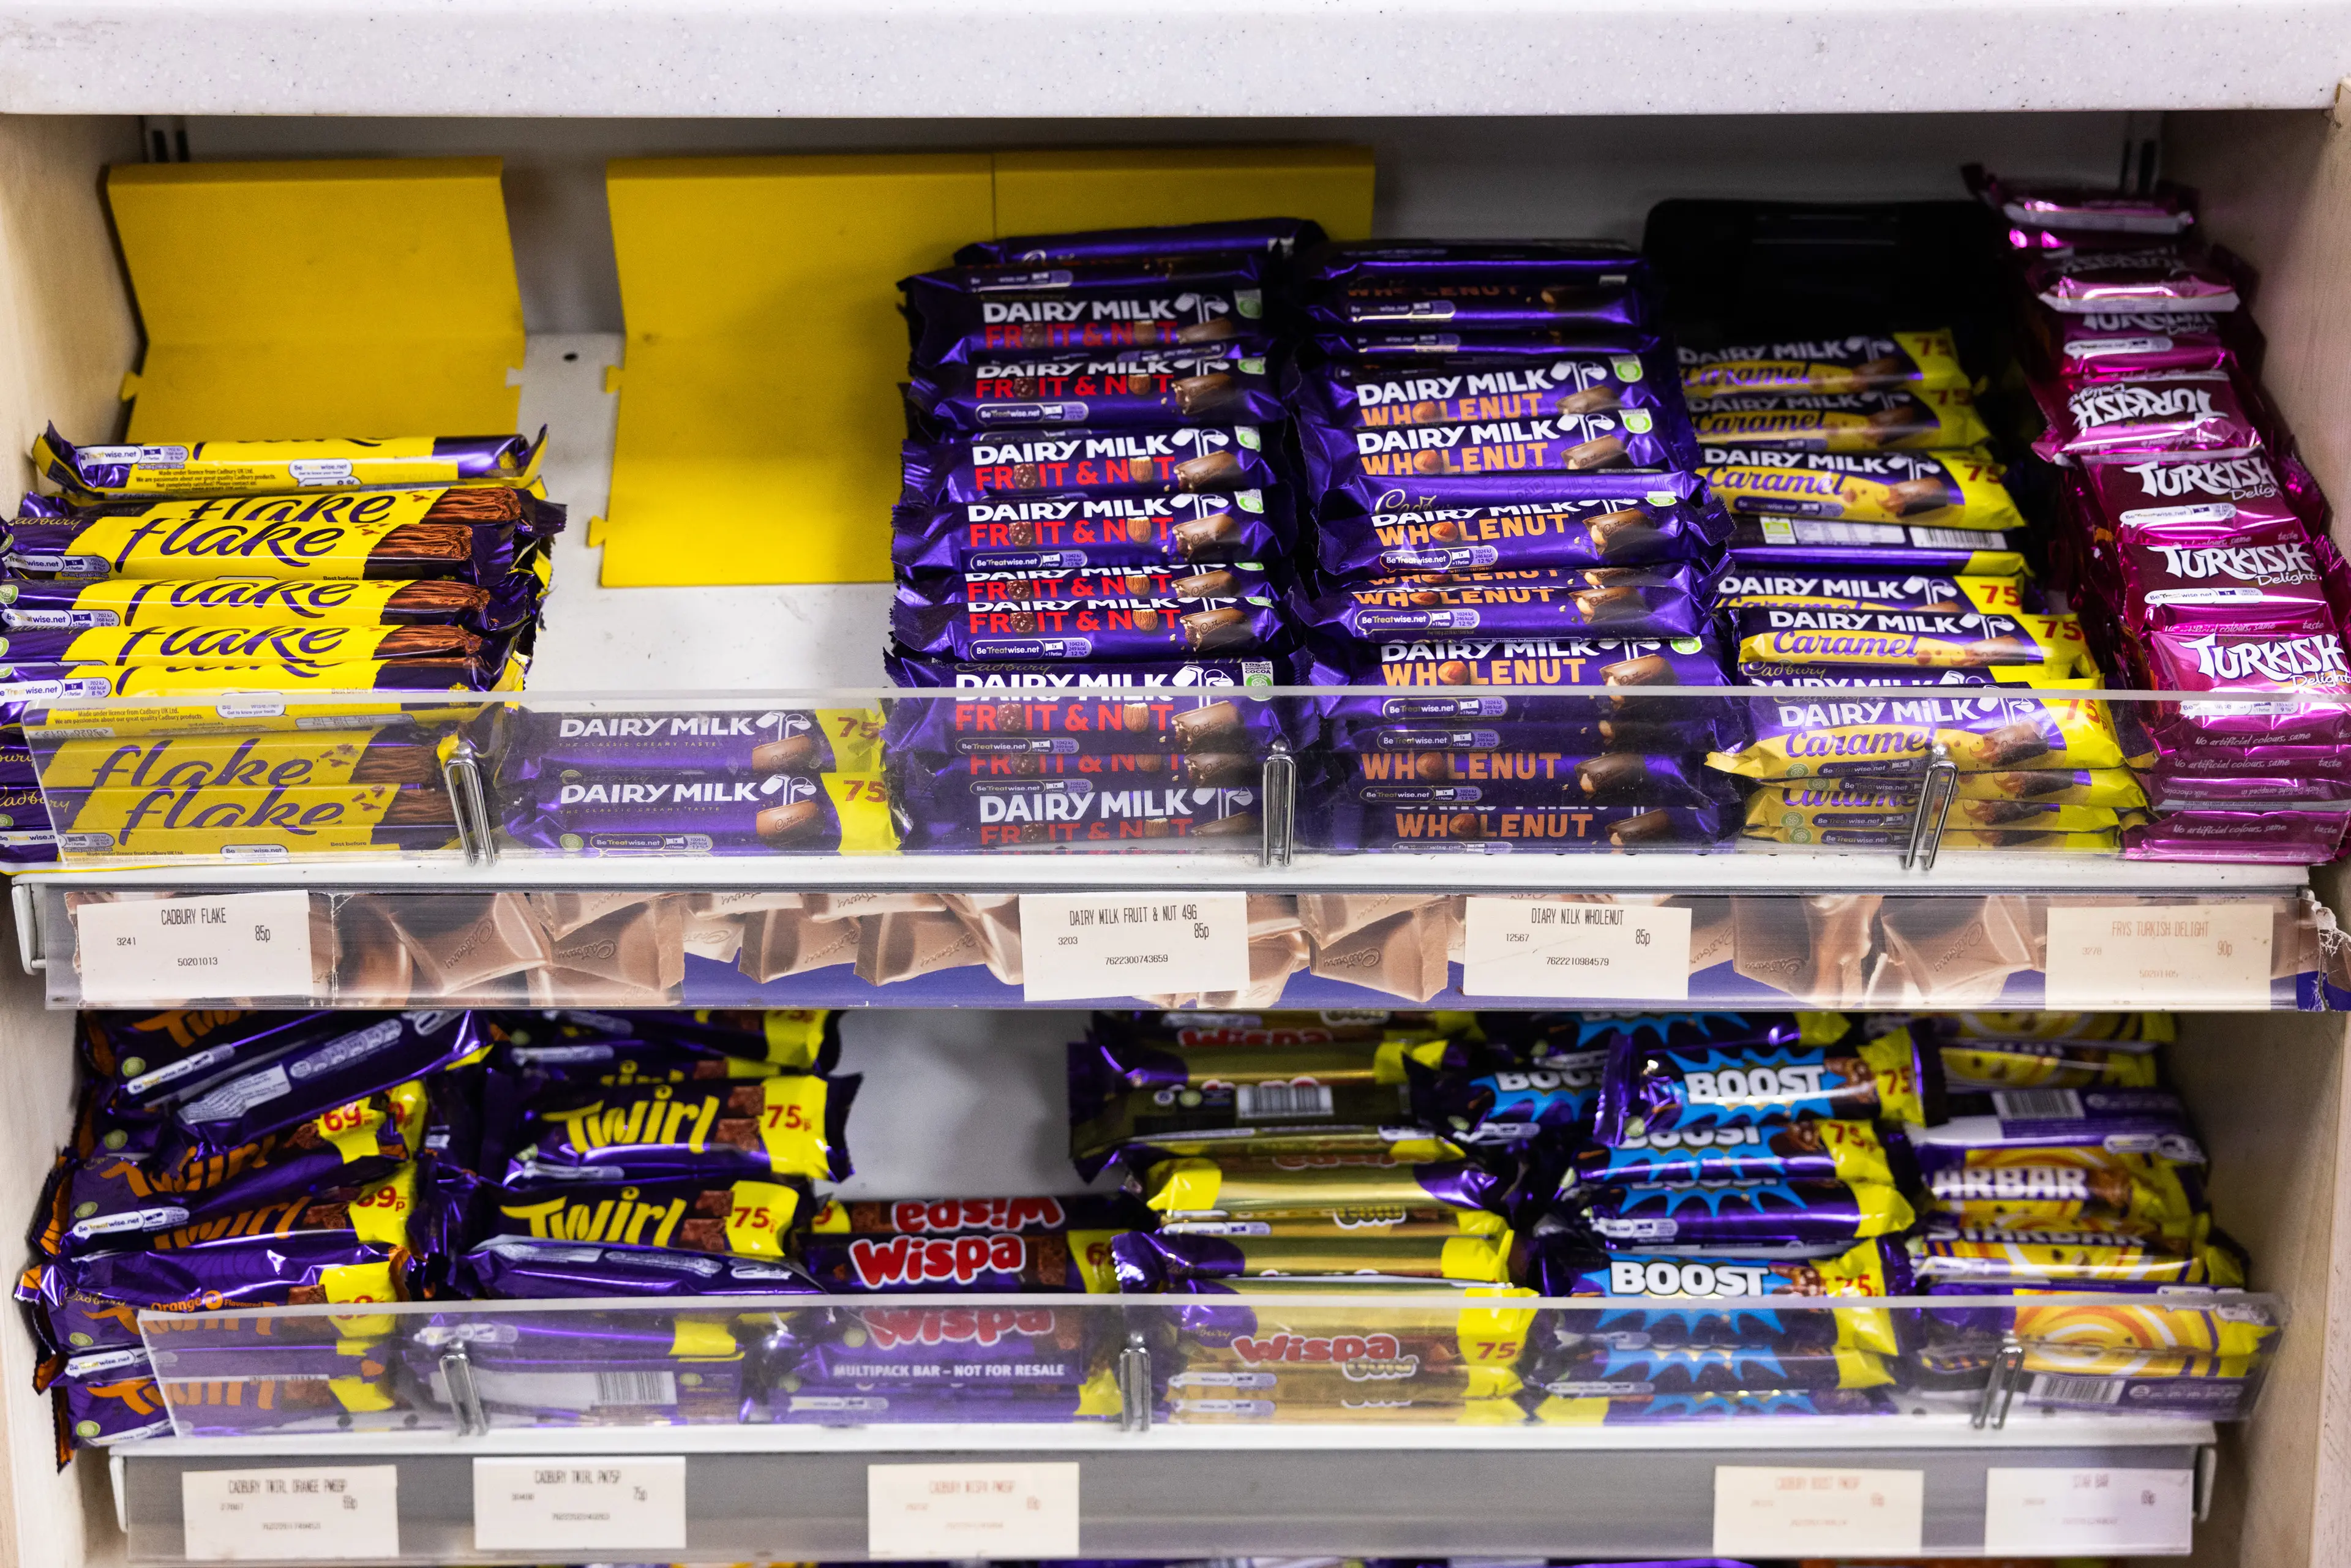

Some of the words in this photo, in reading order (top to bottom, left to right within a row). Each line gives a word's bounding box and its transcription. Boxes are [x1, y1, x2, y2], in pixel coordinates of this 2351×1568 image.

[983, 301, 1087, 323] DAIRY
[1092, 300, 1177, 320] MILK
[1355, 376, 1463, 407] DAIRY
[1469, 369, 1554, 394] MILK
[1356, 424, 1466, 455] DAIRY
[1471, 419, 1561, 446] MILK
[973, 440, 1082, 466] DAIRY
[1087, 435, 1174, 462] MILK
[1360, 443, 1549, 475] WHLENUT
[1704, 448, 1800, 468] DAIRY
[1807, 454, 1889, 473] MILK
[1706, 467, 1847, 496] Caramel
[968, 501, 1078, 522] DAIRY
[1083, 498, 1173, 518] MILK
[1371, 508, 1484, 528] DAIRY
[1488, 500, 1582, 519] MILK
[1374, 513, 1569, 547] WHLENUT
[114, 517, 345, 574] flake
[976, 558, 1038, 567] BeTreatwise.net
[1386, 555, 1447, 565] BeTreatwise.net
[1719, 577, 1818, 595] DAIRY
[1824, 579, 1905, 600] MILK
[2257, 571, 2319, 587] Delight
[970, 612, 1069, 634] FRIT
[1076, 610, 1101, 631] &
[1109, 609, 1181, 630] NT
[1362, 615, 1427, 624] BeTreatwise.net
[1770, 612, 1872, 631] DAIRY
[1878, 615, 1962, 634] MILK
[2303, 621, 2325, 630] taste
[2038, 620, 2082, 642] 75
[976, 646, 1040, 655] BeTreatwise.net
[1381, 643, 1499, 662] DAIRY
[1504, 640, 1600, 659] MILK
[1774, 629, 1919, 658] Caramel
[2292, 672, 2351, 688] Delight
[140, 708, 160, 716] Cadbury
[140, 715, 157, 724] quality
[158, 713, 179, 723] Cadbury
[180, 713, 204, 722] products.
[956, 704, 1059, 732] FRIT
[1098, 703, 1174, 731] NT
[1389, 704, 1454, 714] BeTreatwise.net
[1779, 702, 1886, 727] DAIRY
[1892, 699, 1981, 724] MILK
[560, 718, 668, 737] DAIRY
[670, 717, 756, 736] MILK
[962, 742, 1026, 751] BeTreatwise.net
[1383, 737, 1447, 745] BeTreatwise.net
[1785, 724, 1937, 758] Caramel
[2195, 737, 2207, 745] No
[2210, 735, 2250, 746] artificial
[2253, 734, 2286, 744] colours,
[91, 738, 313, 786] flake
[1362, 753, 1561, 780] WHLENUT
[1823, 765, 1886, 775] BeTreatwise.net
[2188, 760, 2229, 771] artificial
[2318, 758, 2342, 767] taste
[560, 784, 671, 804] DAIRY
[673, 782, 760, 802] MILK
[118, 784, 345, 847] flake
[980, 793, 1095, 823] DAIRY
[1101, 789, 1193, 819] MILK
[596, 838, 661, 847] BeTreatwise.net
[161, 909, 196, 925] CADBURY
[201, 907, 226, 923] FLAKE
[1070, 910, 1094, 926] DAIRY
[1099, 908, 1119, 925] MILK
[1123, 907, 1147, 923] FRUIT
[1153, 907, 1158, 921] &
[1163, 906, 1177, 921] NUT
[1182, 904, 1197, 920] 49G
[1531, 908, 1556, 924] DIARY
[1585, 909, 1624, 926] WHOLENUT
[255, 925, 271, 943] 85p
[1194, 923, 1209, 940] 85p
[1505, 933, 1529, 942] 12567
[1635, 929, 1651, 947] 85p
[2112, 921, 2132, 937] FRYS
[2136, 921, 2171, 937] TURKISH
[2175, 921, 2209, 937] DELIGHT
[116, 937, 137, 946] 3241
[1058, 936, 1078, 945] 3203
[2217, 940, 2233, 957] 90p
[178, 957, 218, 967] 50201013
[1105, 954, 1168, 966] 7622300743659
[1546, 956, 1609, 966] 7622210984579
[1684, 1065, 1827, 1105] BOOST
[542, 1085, 720, 1155] Twirl
[500, 1186, 687, 1247] Twirl
[849, 1235, 1026, 1289] Wispa
[1610, 1261, 1770, 1296] BOOST
[151, 1296, 201, 1312] Orange
[224, 1299, 262, 1308] Flavoured
[1231, 1333, 1400, 1367] Wispa
[833, 1365, 910, 1377] MULTIPACK
[914, 1365, 940, 1377] BAR
[953, 1365, 981, 1377] NOT
[985, 1365, 1011, 1376] FOR
[1015, 1364, 1065, 1376] RESALE
